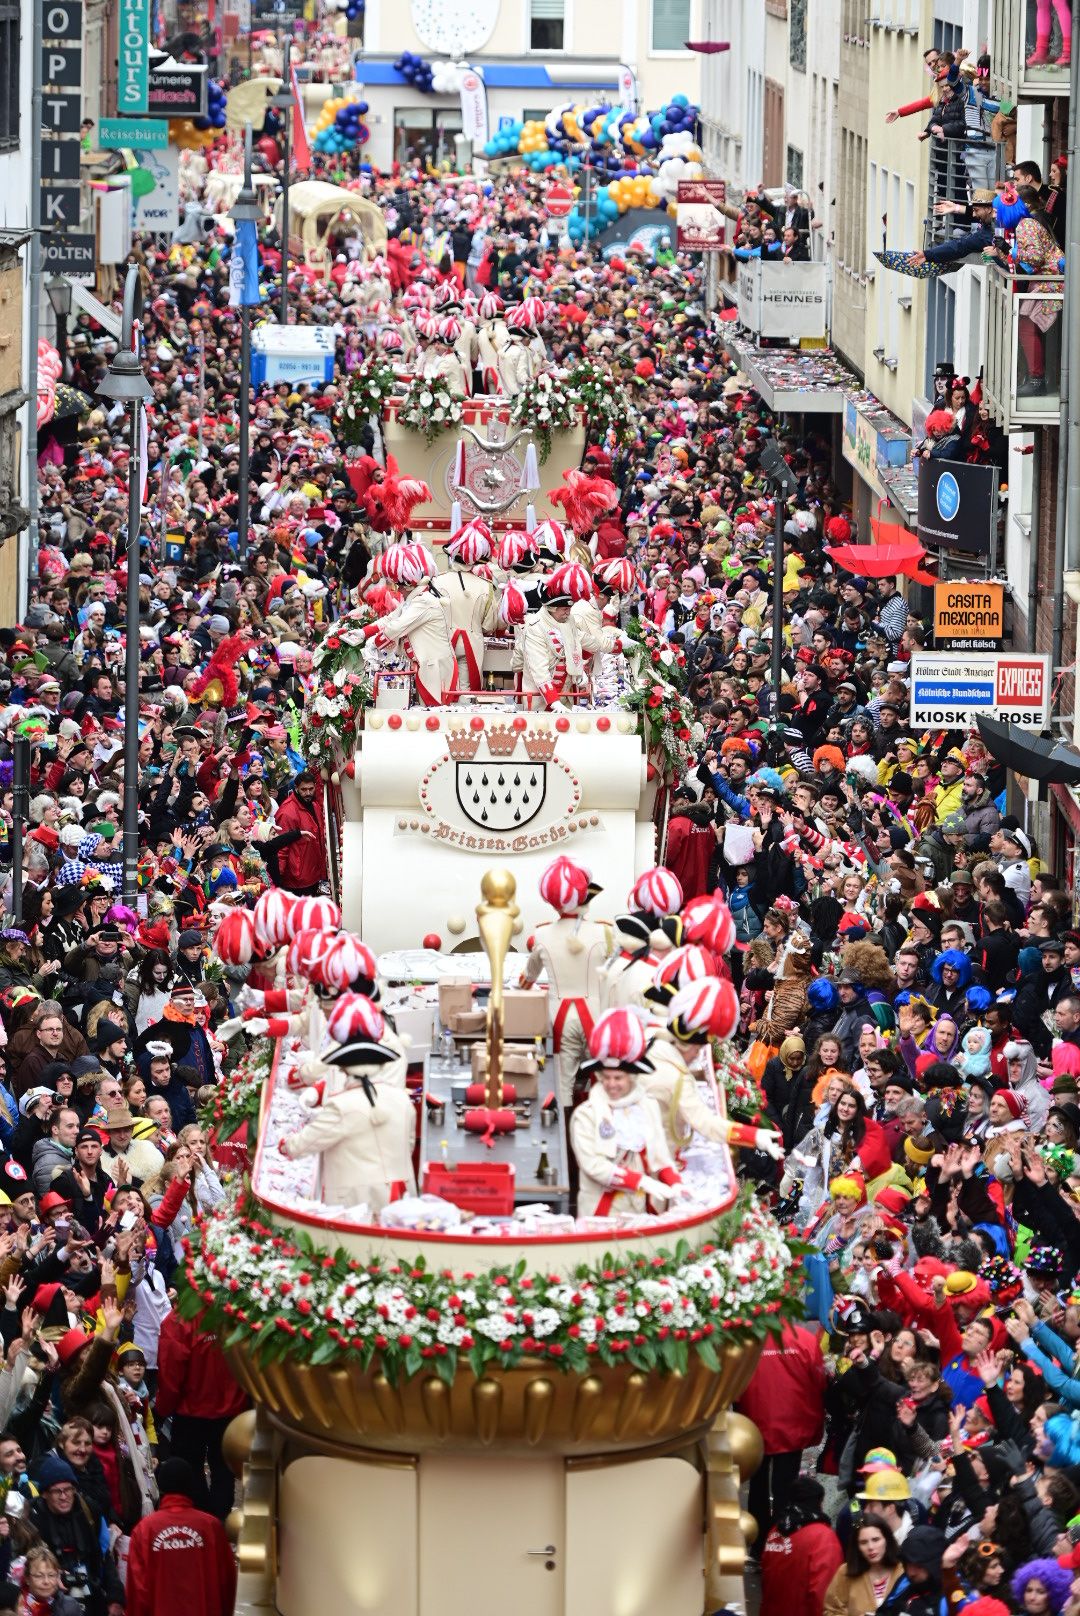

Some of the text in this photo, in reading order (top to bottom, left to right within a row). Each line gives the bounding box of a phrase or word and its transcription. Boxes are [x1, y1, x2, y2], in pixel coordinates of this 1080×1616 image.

[46, 7, 70, 221] OPTIK
[101, 127, 166, 140] Reisebüro
[143, 208, 168, 218] WDR
[763, 295, 823, 303] HENNES
[171, 545, 179, 558] P
[947, 594, 991, 608] CASITA
[939, 611, 999, 625] MEXICANA
[951, 640, 996, 649] Gaffel Kölsch
[915, 666, 940, 676] Kölner
[999, 668, 1042, 697] EXPRESS
[917, 687, 991, 699] Kölnische Rundschau
[915, 711, 1042, 724] KIOSK ROSE
[163, 1538, 195, 1550] KÖLN
